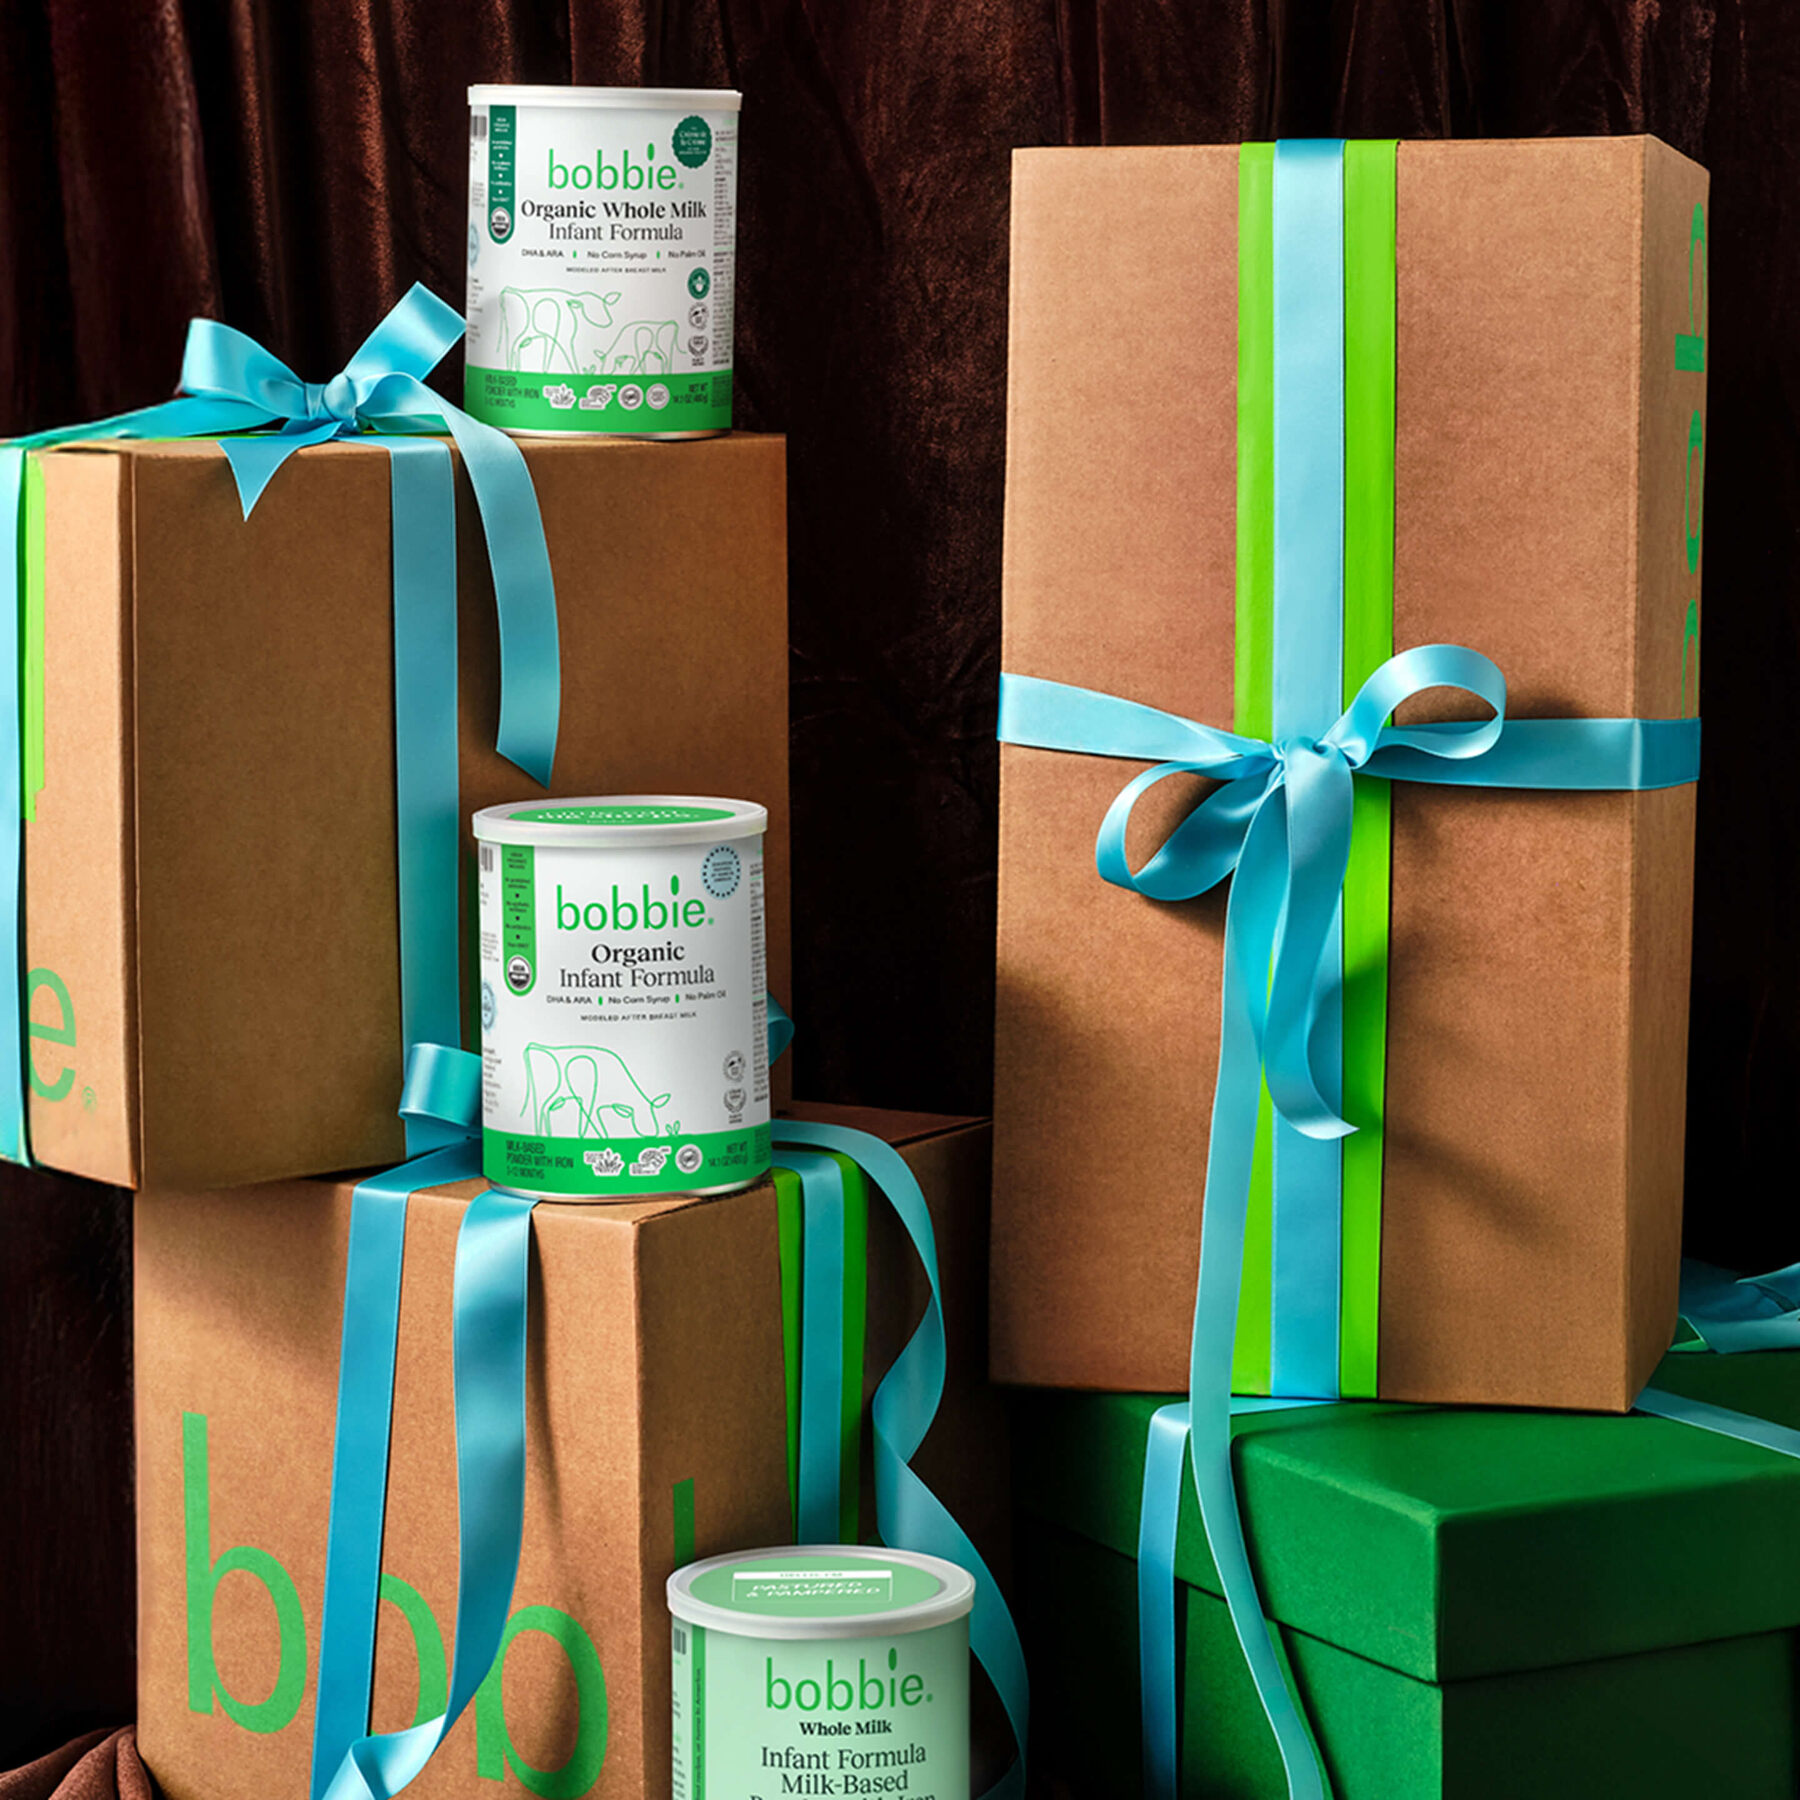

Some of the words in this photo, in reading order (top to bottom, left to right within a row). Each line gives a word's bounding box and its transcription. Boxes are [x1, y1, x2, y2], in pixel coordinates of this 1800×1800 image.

[521, 199, 597, 222] Organic
[602, 200, 666, 219] Whole
[670, 200, 707, 219] Milk
[549, 222, 602, 241] Infant
[610, 223, 684, 241] Formula
[587, 251, 599, 259] No
[601, 251, 623, 260] Corn
[624, 251, 648, 261] Syrup
[667, 249, 679, 258] No
[679, 249, 697, 258] Palm
[591, 941, 685, 968] Organic
[559, 967, 623, 988] Infant
[631, 964, 715, 988] Formula
[608, 996, 621, 1004] No
[623, 995, 645, 1004] Corn
[647, 995, 671, 1006] Syrup
[685, 991, 697, 1000] No
[697, 990, 716, 999] Palm
[580, 1014, 620, 1022] MODELED
[649, 1013, 677, 1021] BREAST
[679, 1011, 697, 1019] MILK
[799, 1721, 852, 1736] Whole
[854, 1719, 893, 1735] Milk
[761, 1746, 831, 1770] Infant
[837, 1743, 927, 1770] Formula
[781, 1770, 909, 1795] Milk-Based
